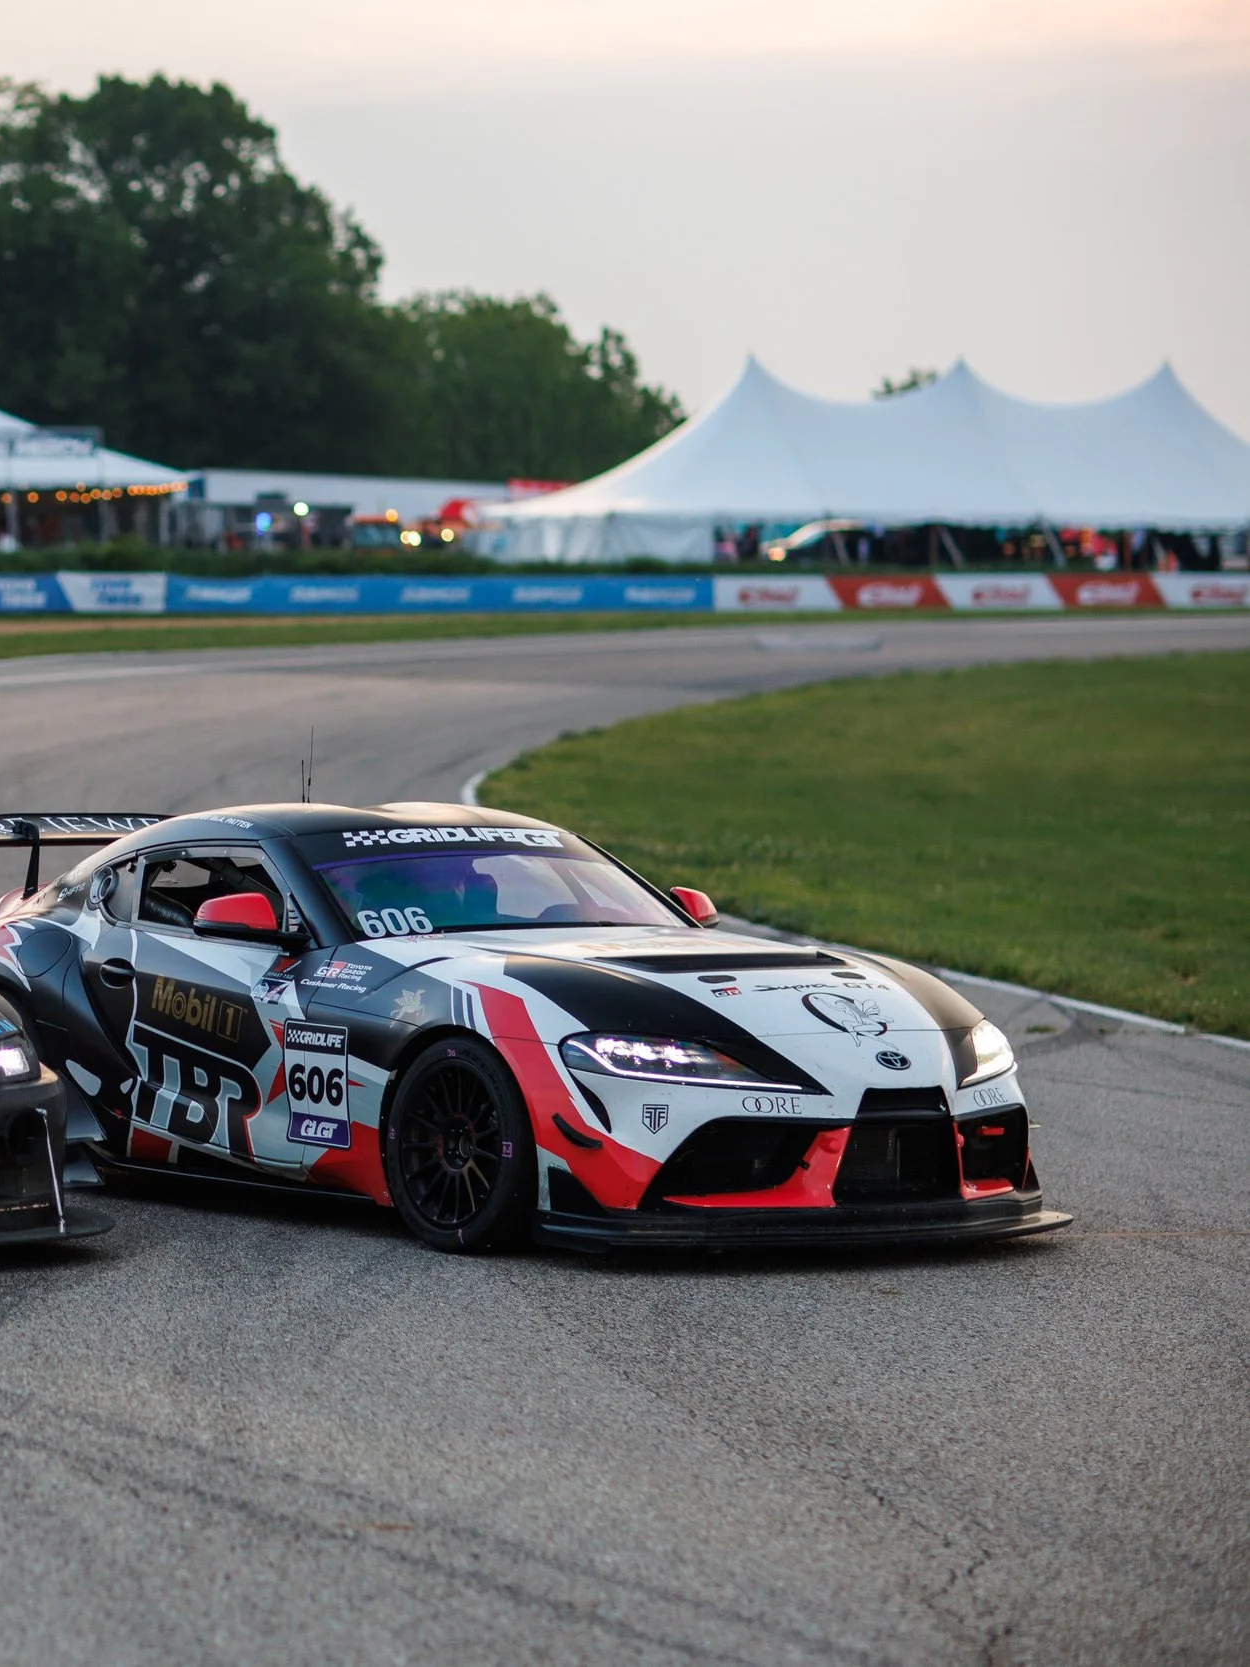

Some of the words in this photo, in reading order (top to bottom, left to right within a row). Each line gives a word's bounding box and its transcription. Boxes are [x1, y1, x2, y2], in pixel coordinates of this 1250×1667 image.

[357, 907, 433, 938] 606
[342, 968, 366, 976] GAZOO
[346, 963, 372, 971] TOYOTA
[338, 974, 362, 982] Racing
[300, 979, 338, 989] Customer
[337, 982, 367, 993] Racing
[752, 983, 837, 992] Supra
[843, 982, 890, 991] GT4
[151, 974, 217, 1033] Mobil
[299, 1031, 345, 1048] GRIDLIFE
[289, 1064, 344, 1106] 606
[300, 1119, 338, 1138] GLGT
